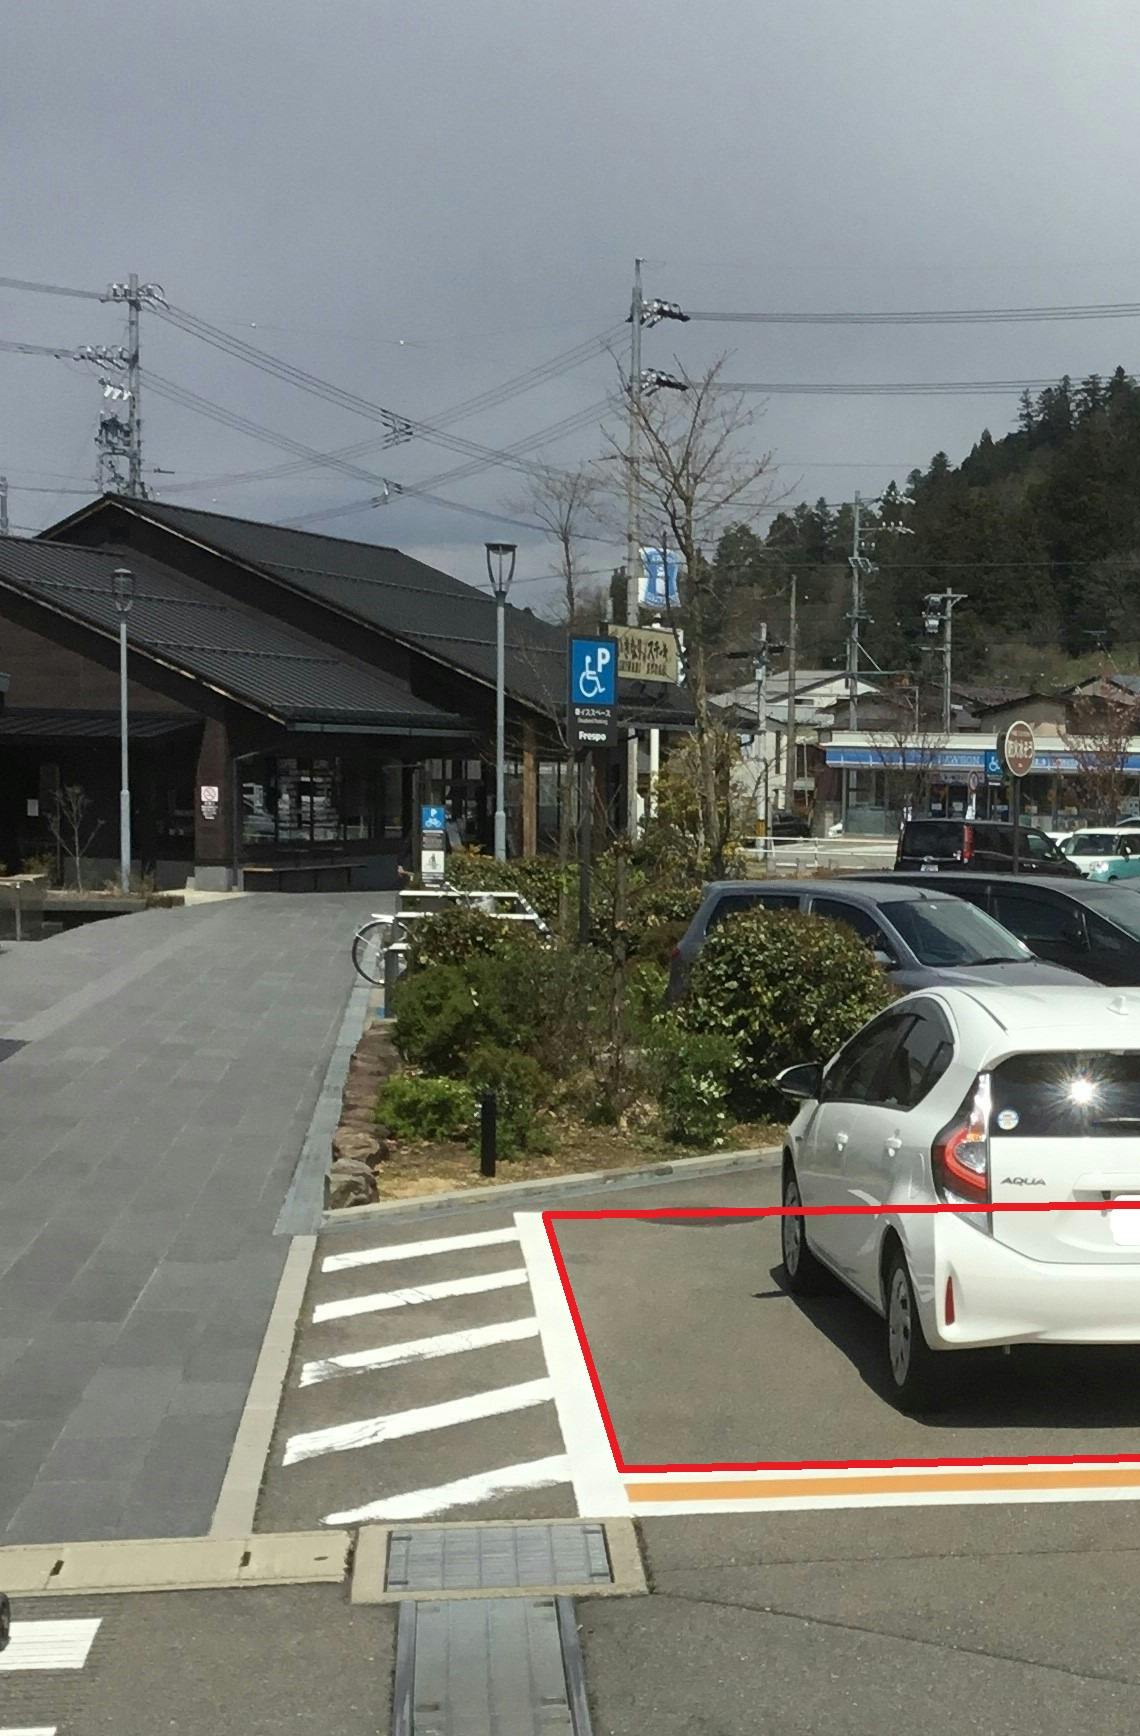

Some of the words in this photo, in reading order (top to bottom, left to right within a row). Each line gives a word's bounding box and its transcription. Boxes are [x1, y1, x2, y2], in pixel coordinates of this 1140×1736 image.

[597, 647, 610, 672] P
[578, 730, 607, 742] Frespo
[1000, 1176, 1047, 1187] AQUA
